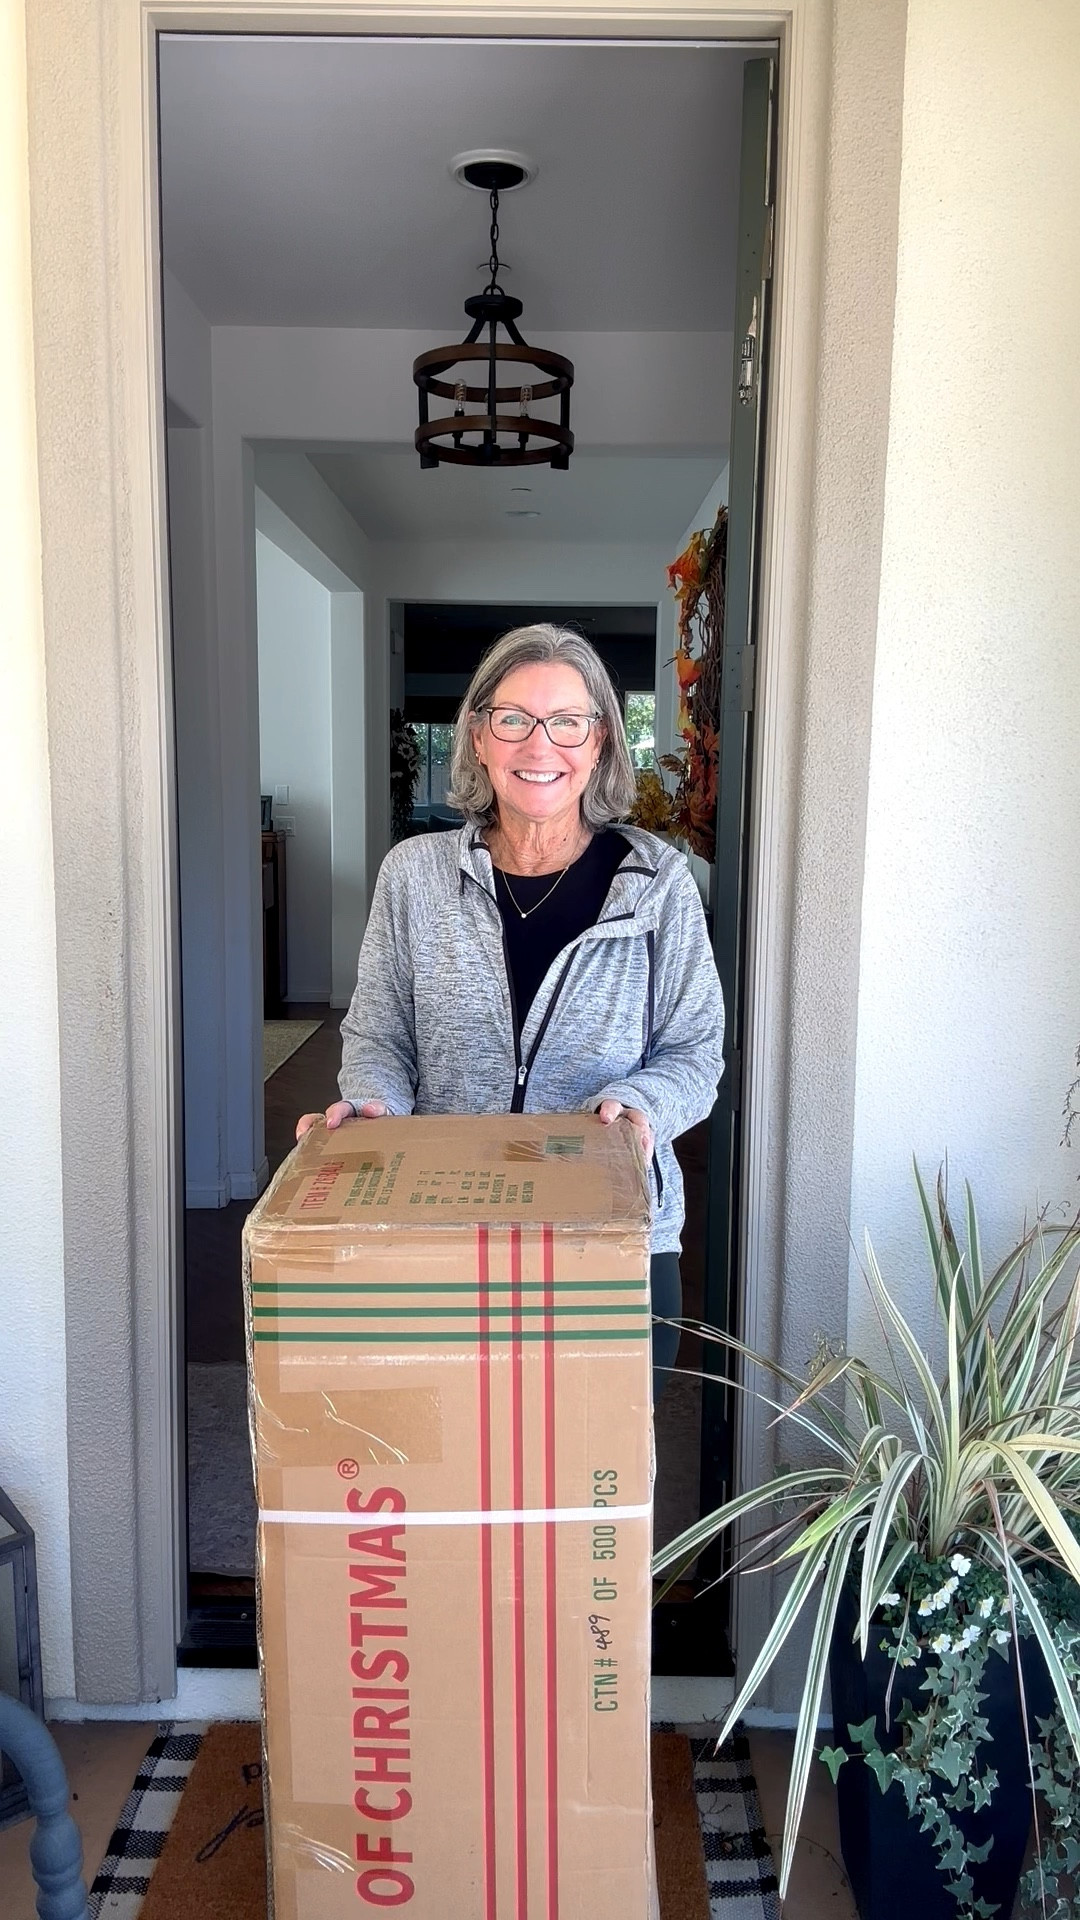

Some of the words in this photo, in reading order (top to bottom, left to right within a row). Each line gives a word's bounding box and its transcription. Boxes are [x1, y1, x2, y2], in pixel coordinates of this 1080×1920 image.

[299, 1191, 330, 1210] ITEM
[593, 1525, 617, 1560] 500
[593, 1577, 618, 1601] OF
[588, 1614, 613, 1651] 489
[356, 1832, 415, 1908] OF
